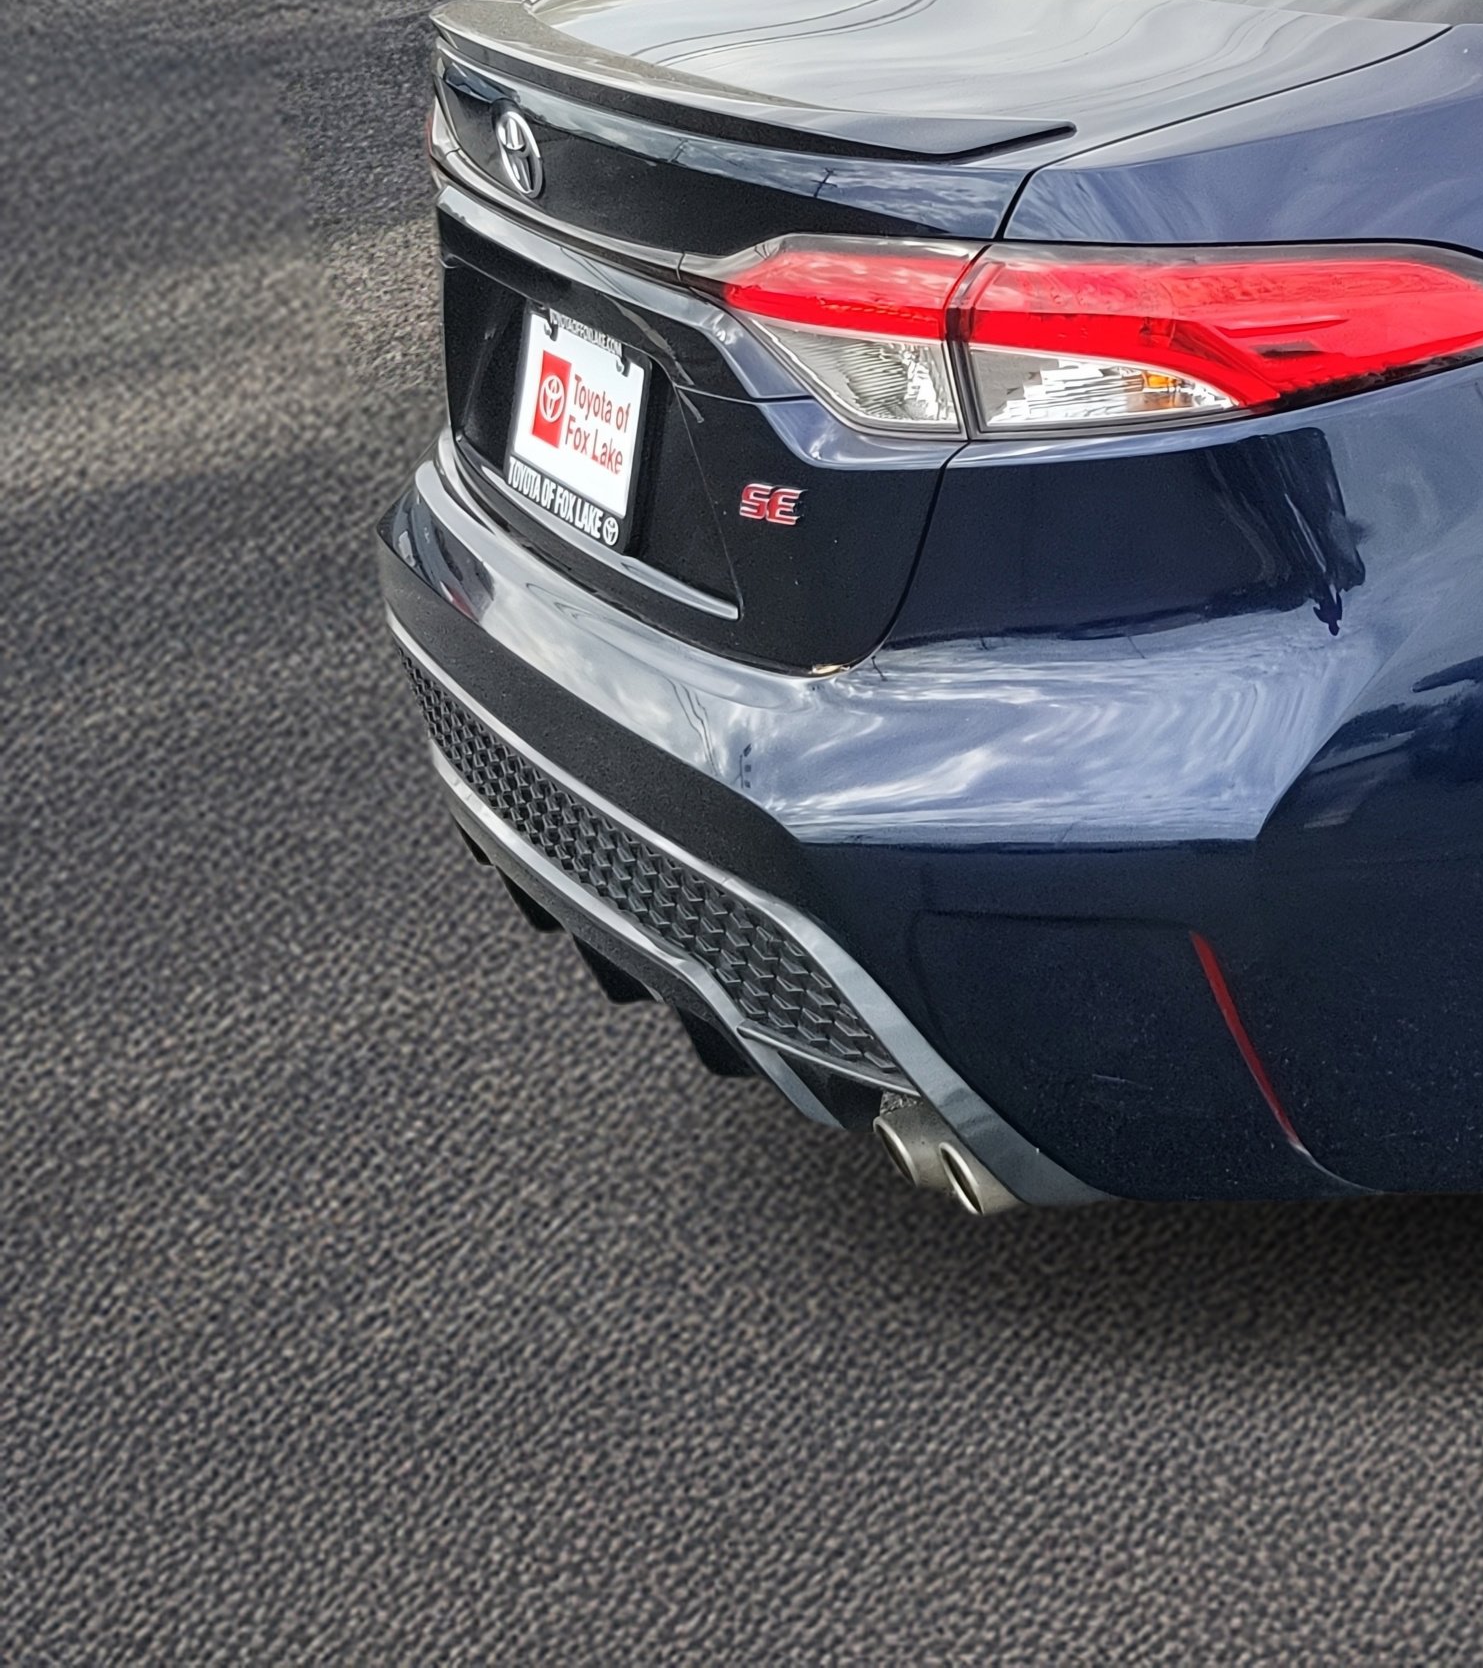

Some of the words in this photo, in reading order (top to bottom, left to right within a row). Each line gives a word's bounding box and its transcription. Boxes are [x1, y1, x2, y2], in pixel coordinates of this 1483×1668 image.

[574, 373, 613, 425] Toyota
[615, 402, 631, 433] of
[565, 414, 591, 456] Fox
[591, 428, 623, 475] Lake
[508, 456, 542, 503] TOYOTA
[541, 477, 557, 510] OF
[554, 484, 577, 524] FOX
[574, 498, 604, 539] LAKE
[739, 483, 804, 525] SE
